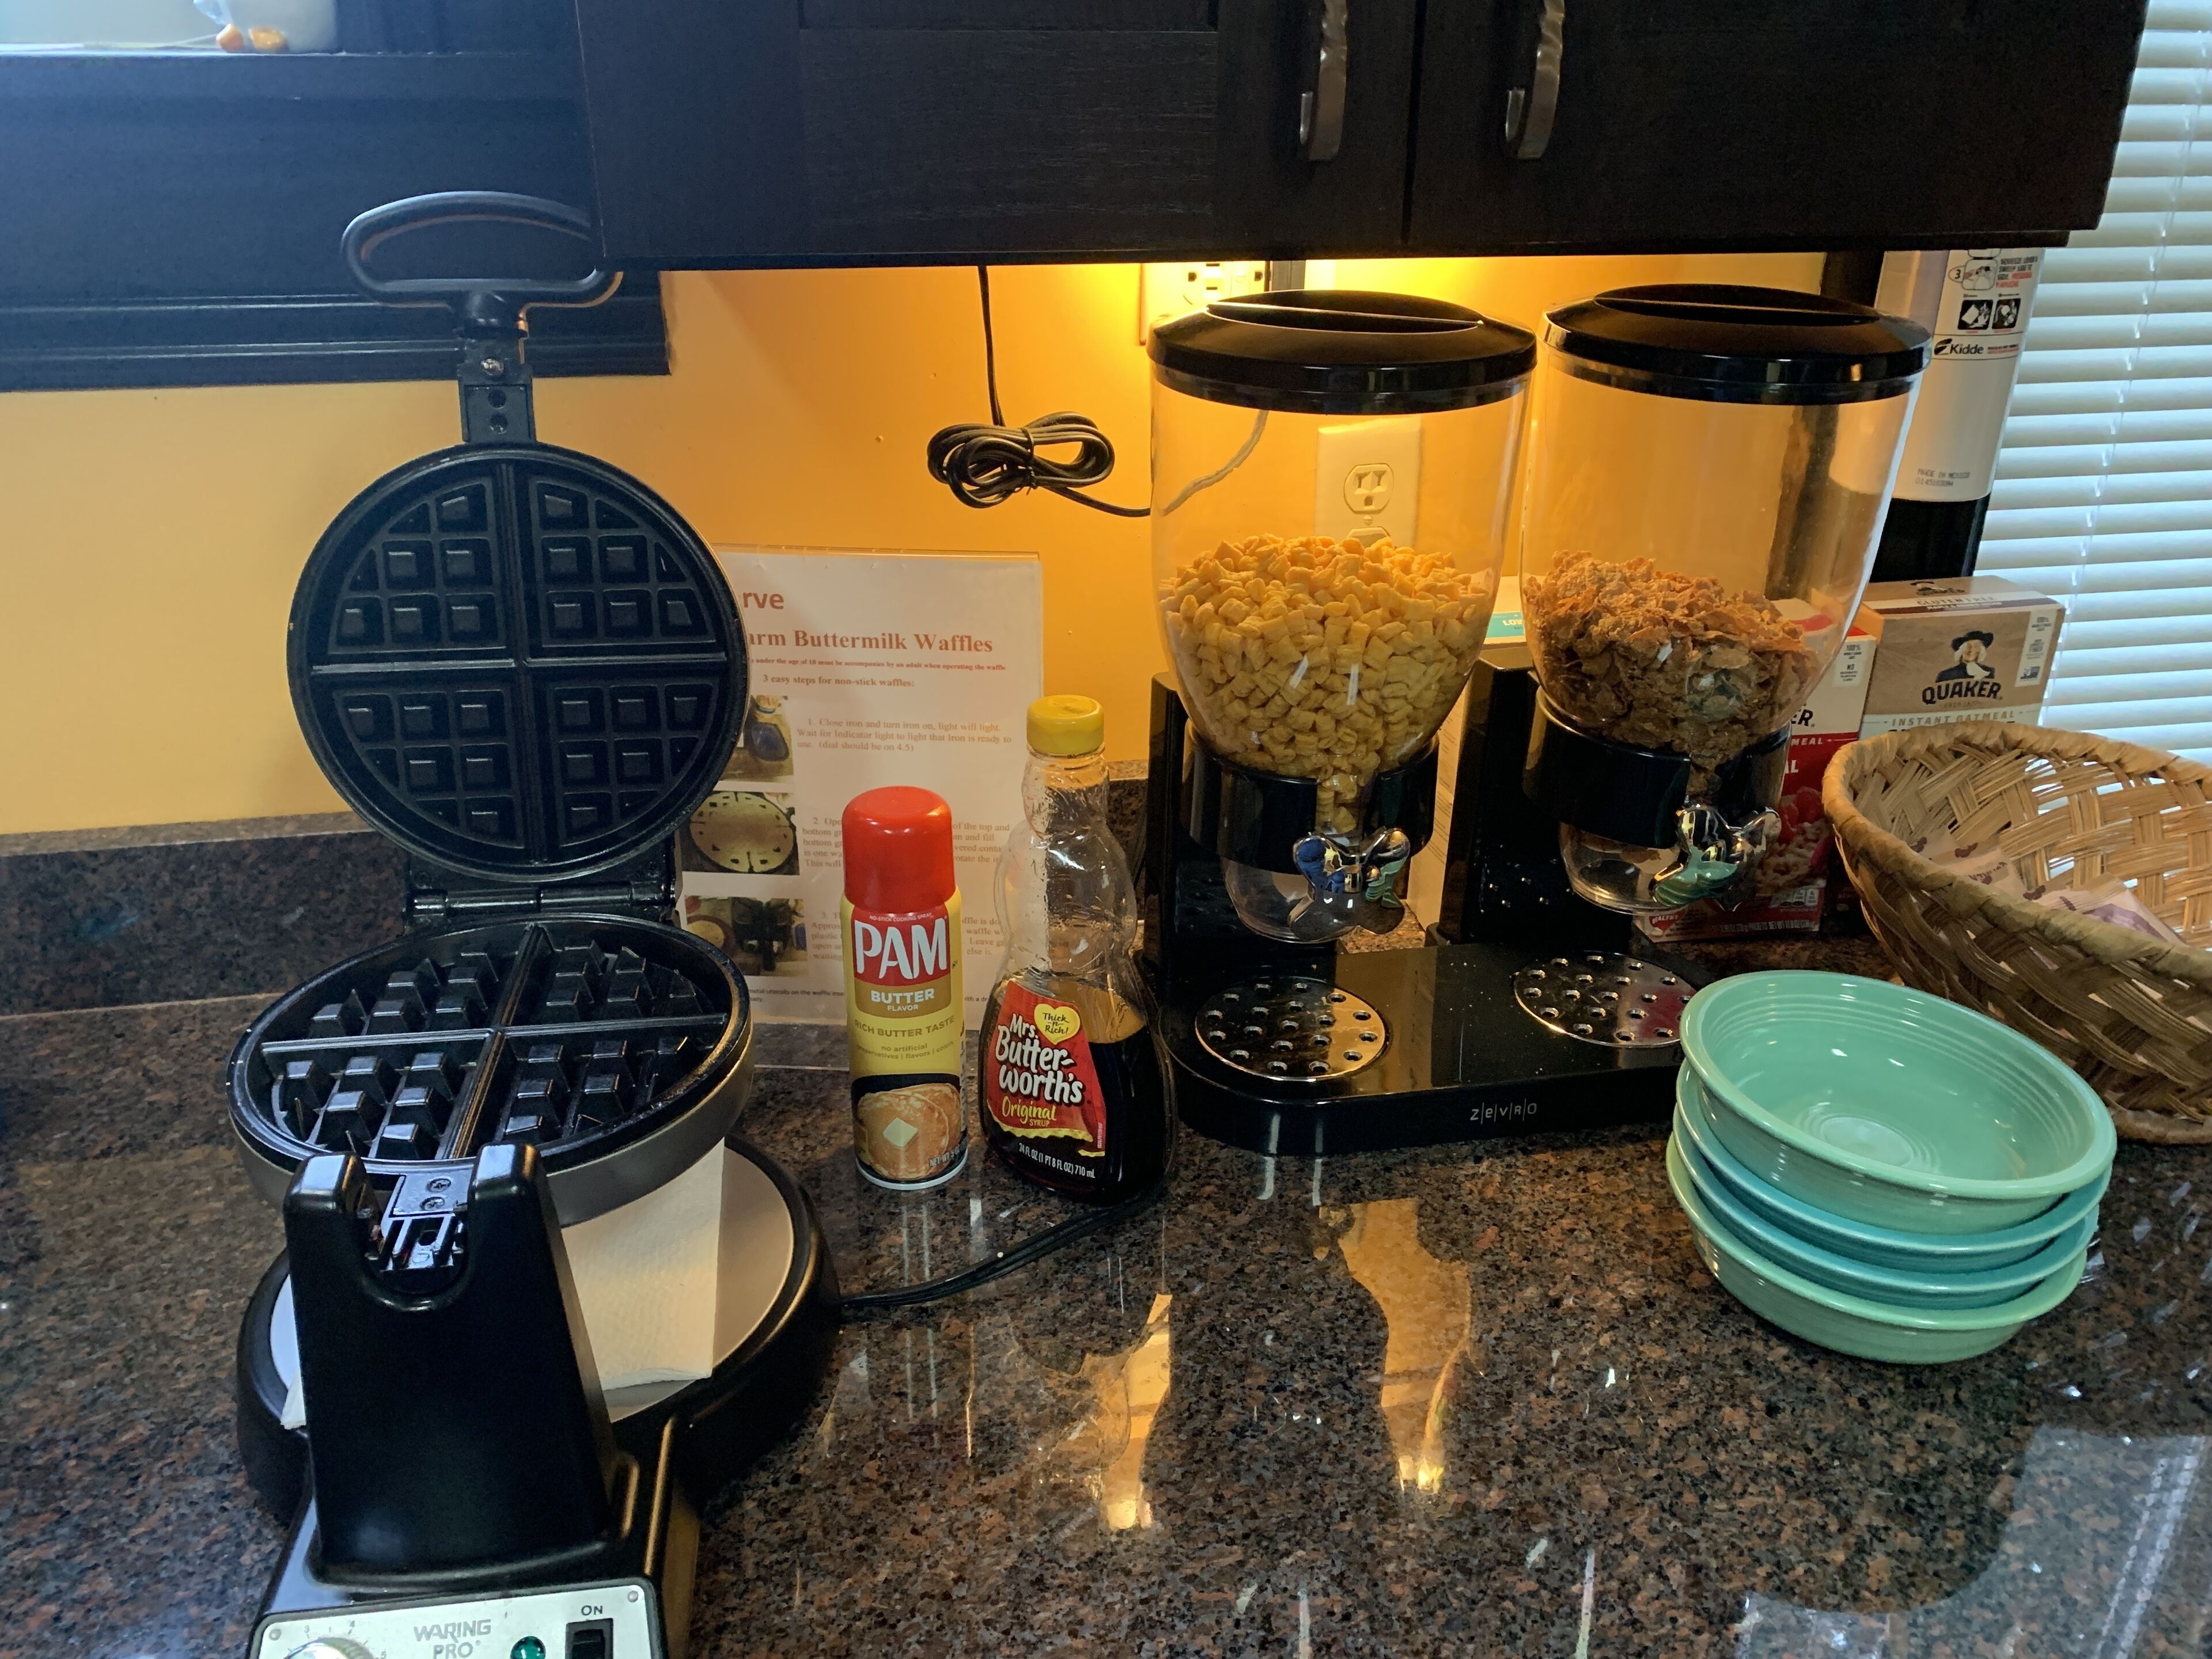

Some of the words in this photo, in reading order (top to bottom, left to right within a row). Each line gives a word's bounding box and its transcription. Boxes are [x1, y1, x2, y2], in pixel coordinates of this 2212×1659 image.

[1955, 269, 1961, 279] 3
[1950, 344, 1983, 354] Kidde
[743, 592, 784, 609] rve
[749, 632, 786, 646] arm
[793, 630, 907, 650] Buttermilk
[913, 633, 993, 653] Waffles
[763, 675, 768, 683] 3
[771, 676, 790, 685] easy
[793, 676, 816, 685] steps
[819, 676, 832, 684] for
[835, 677, 876, 686] non-stick
[879, 679, 915, 687] waffles:
[1922, 681, 2002, 705] QUAKER
[819, 718, 844, 726] Close
[846, 719, 862, 727] iron
[865, 720, 881, 728] and
[903, 721, 920, 729] iron
[938, 722, 957, 732] light
[960, 723, 976, 731] will
[1892, 715, 1952, 727] INSTANT
[1956, 710, 2015, 721] OATMEAL
[797, 728, 817, 737] Wait
[820, 729, 831, 737] for
[835, 730, 872, 739] Indicator
[875, 731, 893, 741] light
[908, 732, 926, 742] light
[929, 733, 945, 741] that
[948, 734, 965, 742] Iron
[968, 734, 975, 743] is
[978, 735, 1000, 744] ready
[1791, 738, 1823, 746] MEAL
[819, 741, 838, 749] (dial
[840, 741, 869, 750] should
[897, 743, 914, 752] 4.5)
[824, 817, 842, 827] Ope
[953, 821, 963, 830] of
[964, 822, 977, 830] the
[979, 824, 993, 832] top
[802, 827, 831, 835] bottom
[965, 833, 980, 841] and
[983, 833, 995, 841] fill
[803, 838, 832, 846] bottom
[805, 859, 823, 867] This
[978, 855, 990, 863] the
[969, 937, 994, 945] Leave
[854, 917, 948, 980] PAM
[870, 988, 935, 1004] BUTTER
[887, 1004, 919, 1012] FLAVOR
[1042, 1012, 1070, 1022] Thick
[854, 1019, 874, 1035] RICH
[877, 1028, 922, 1037] BUTTER
[925, 1015, 955, 1034] TASTE
[1009, 1013, 1039, 1039] Mrs.
[1045, 1025, 1069, 1035] Rich!
[893, 1043, 927, 1052] artificial
[995, 1024, 1075, 1073] Butter-
[906, 1051, 930, 1059] flavors
[999, 1064, 1083, 1104] worth's
[1002, 1096, 1057, 1124] Original
[1029, 1119, 1050, 1127] SYRUP
[1019, 1142, 1025, 1153] 24
[1025, 1146, 1031, 1157] FL
[1031, 1149, 1038, 1161] OZ
[1039, 1152, 1043, 1162] (1
[1045, 1155, 1051, 1166] PT
[1052, 1158, 1056, 1168] 8
[1057, 1159, 1063, 1171] FL
[1064, 1162, 1074, 1175] OZ)
[1075, 1165, 1086, 1176] 710
[1086, 1169, 1096, 1179] mL
[581, 1605, 603, 1616] ON
[304, 1625, 310, 1634] 3
[413, 1619, 491, 1643] WARING
[433, 1642, 474, 1659] PRO
